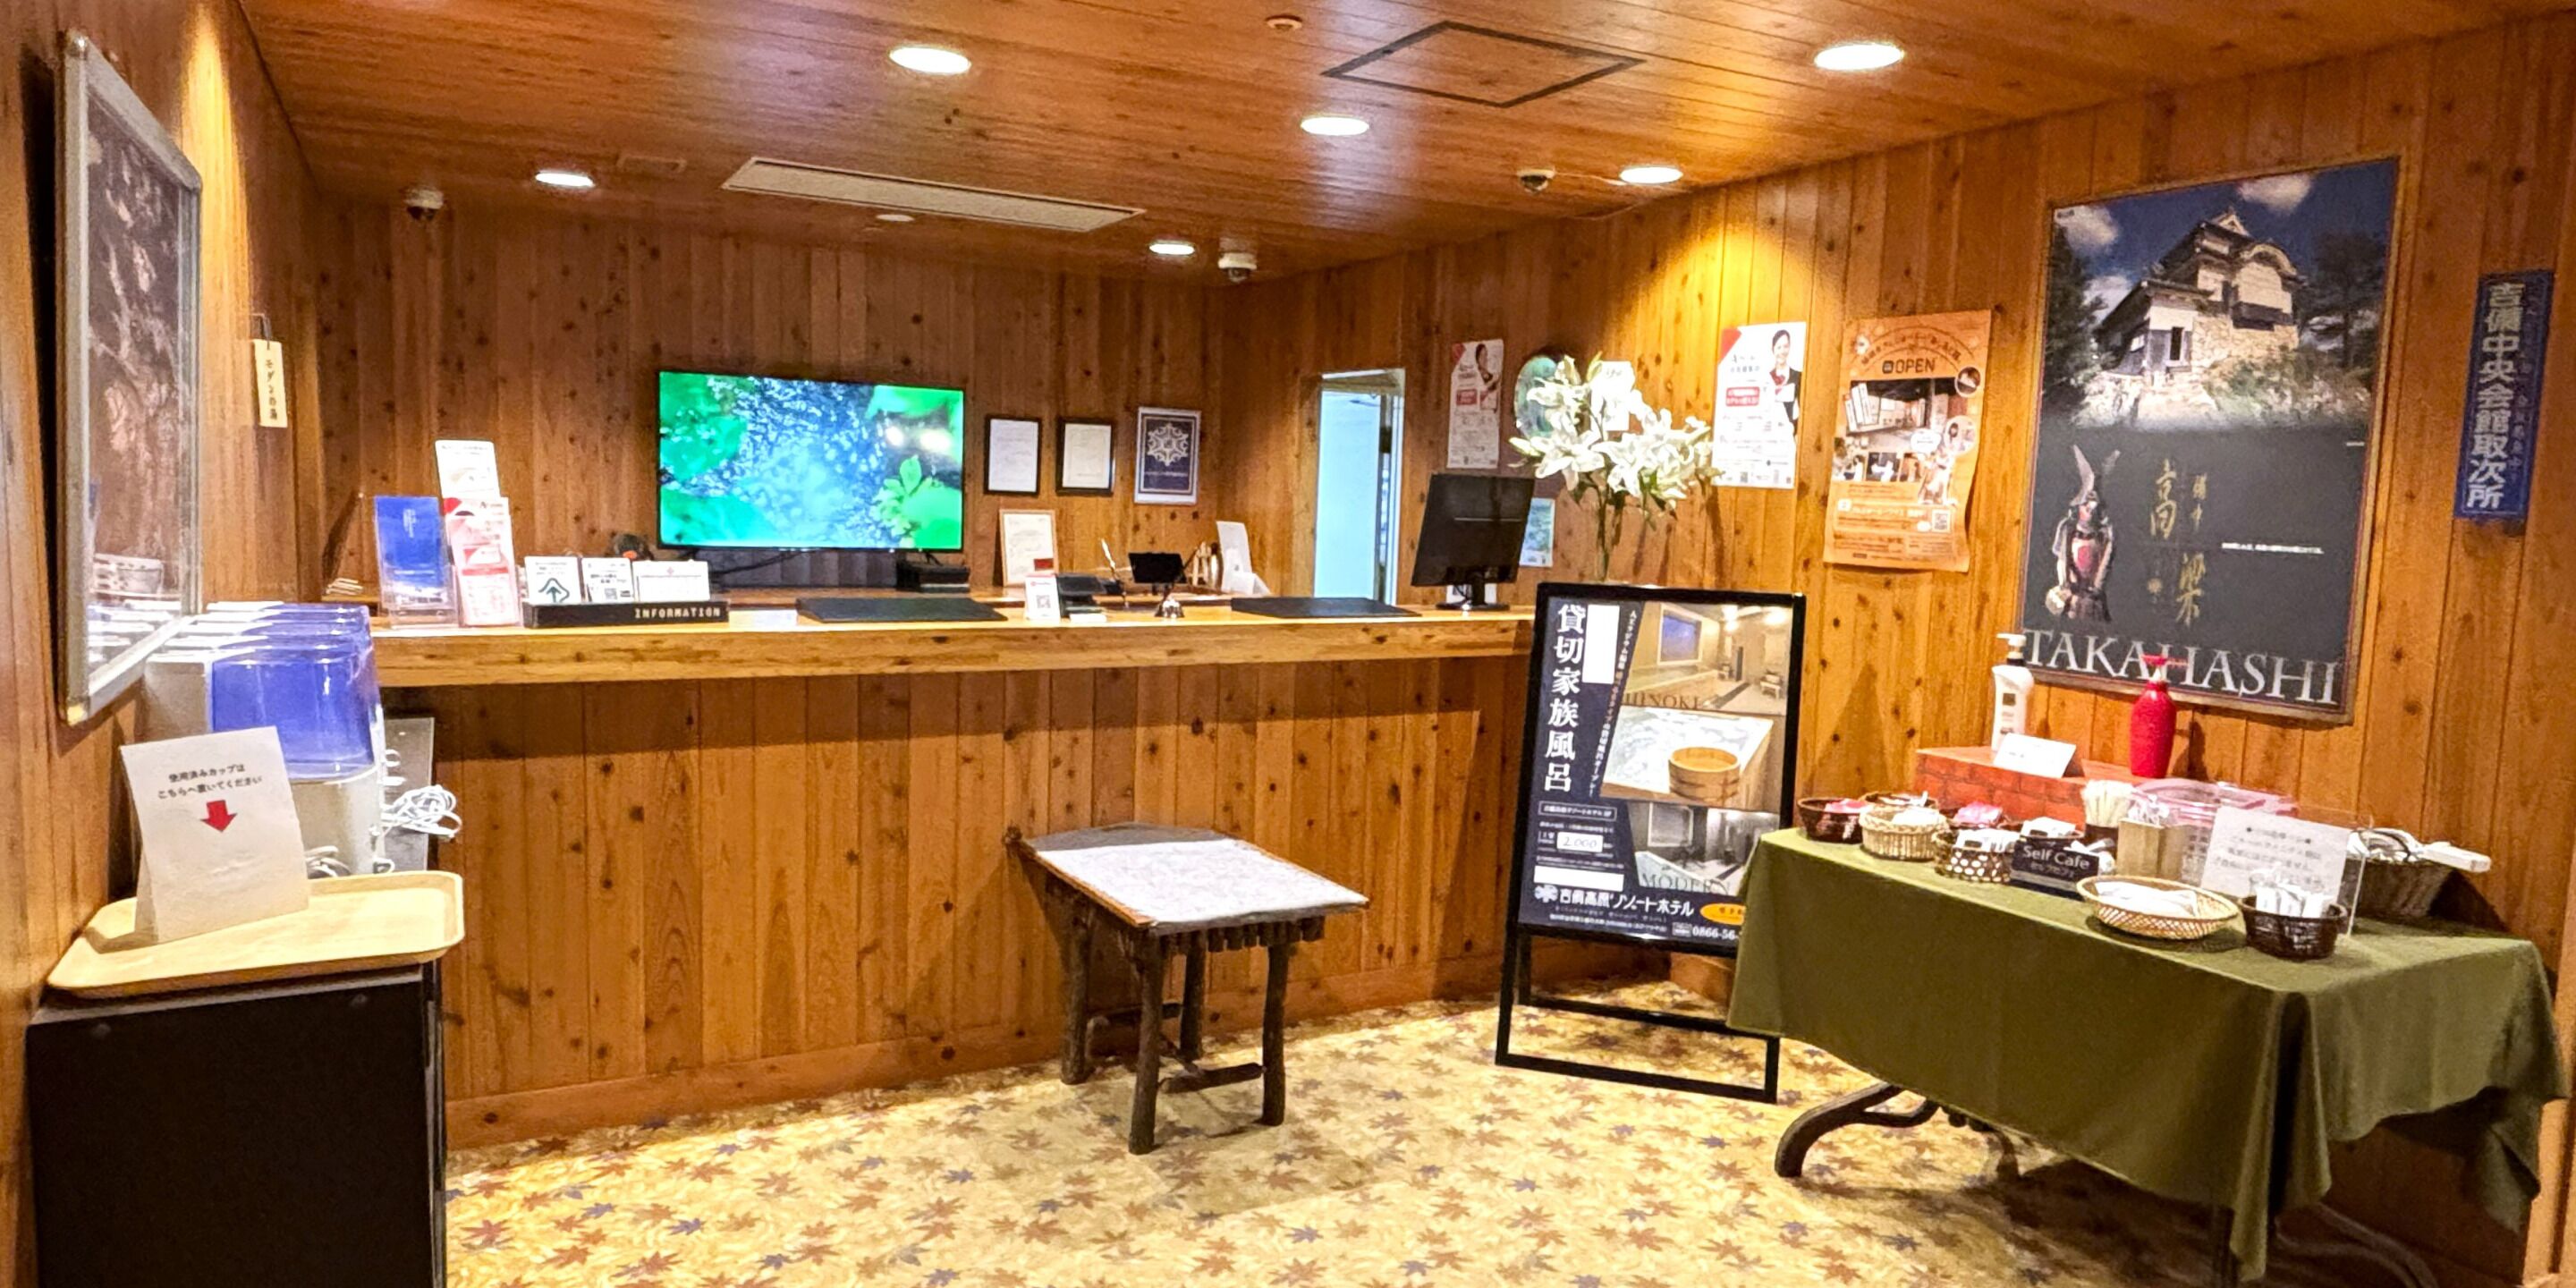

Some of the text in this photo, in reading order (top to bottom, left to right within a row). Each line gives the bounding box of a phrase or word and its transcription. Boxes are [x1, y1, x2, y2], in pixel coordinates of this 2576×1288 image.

[1895, 358, 1936, 374] OPEN
[2466, 282, 2525, 509] 吉備中央会館取次所
[634, 608, 721, 619] INFORMATION
[2024, 629, 2340, 705] TAKAHASHI
[1544, 604, 1587, 793] 貸切家族風呂
[168, 763, 246, 784] 使用済みカップは
[158, 775, 263, 800] こちらへ置いてください
[2023, 845, 2090, 869] Self Cafe
[1559, 888, 1695, 917] 吉備高原リゾートホテル
[1692, 926, 1742, 940] 0866-56-
